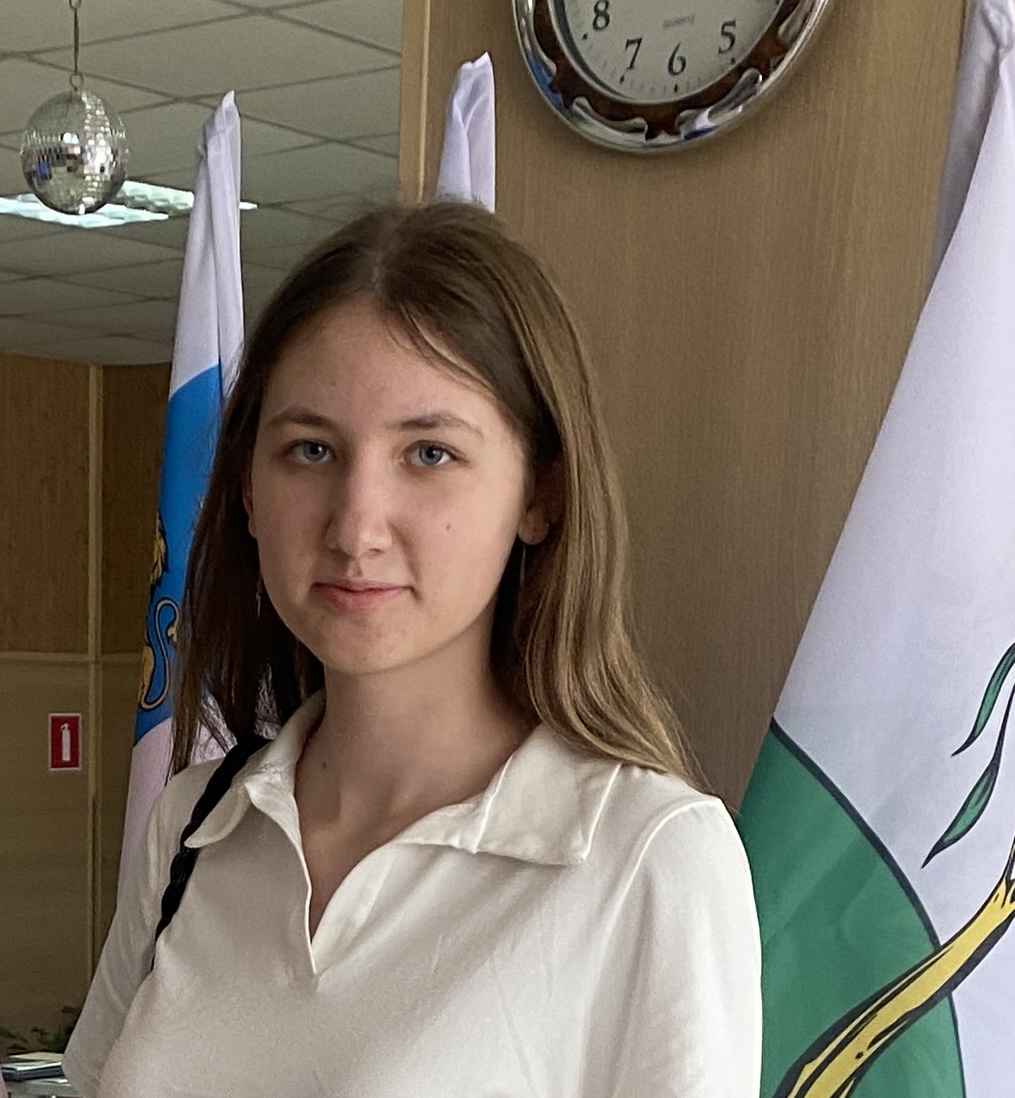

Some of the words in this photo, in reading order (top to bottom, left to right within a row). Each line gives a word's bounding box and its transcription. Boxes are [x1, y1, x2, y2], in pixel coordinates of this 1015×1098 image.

[592, 0, 611, 30] 8
[718, 20, 737, 54] 5
[625, 38, 643, 70] 7
[668, 43, 687, 76] 6
